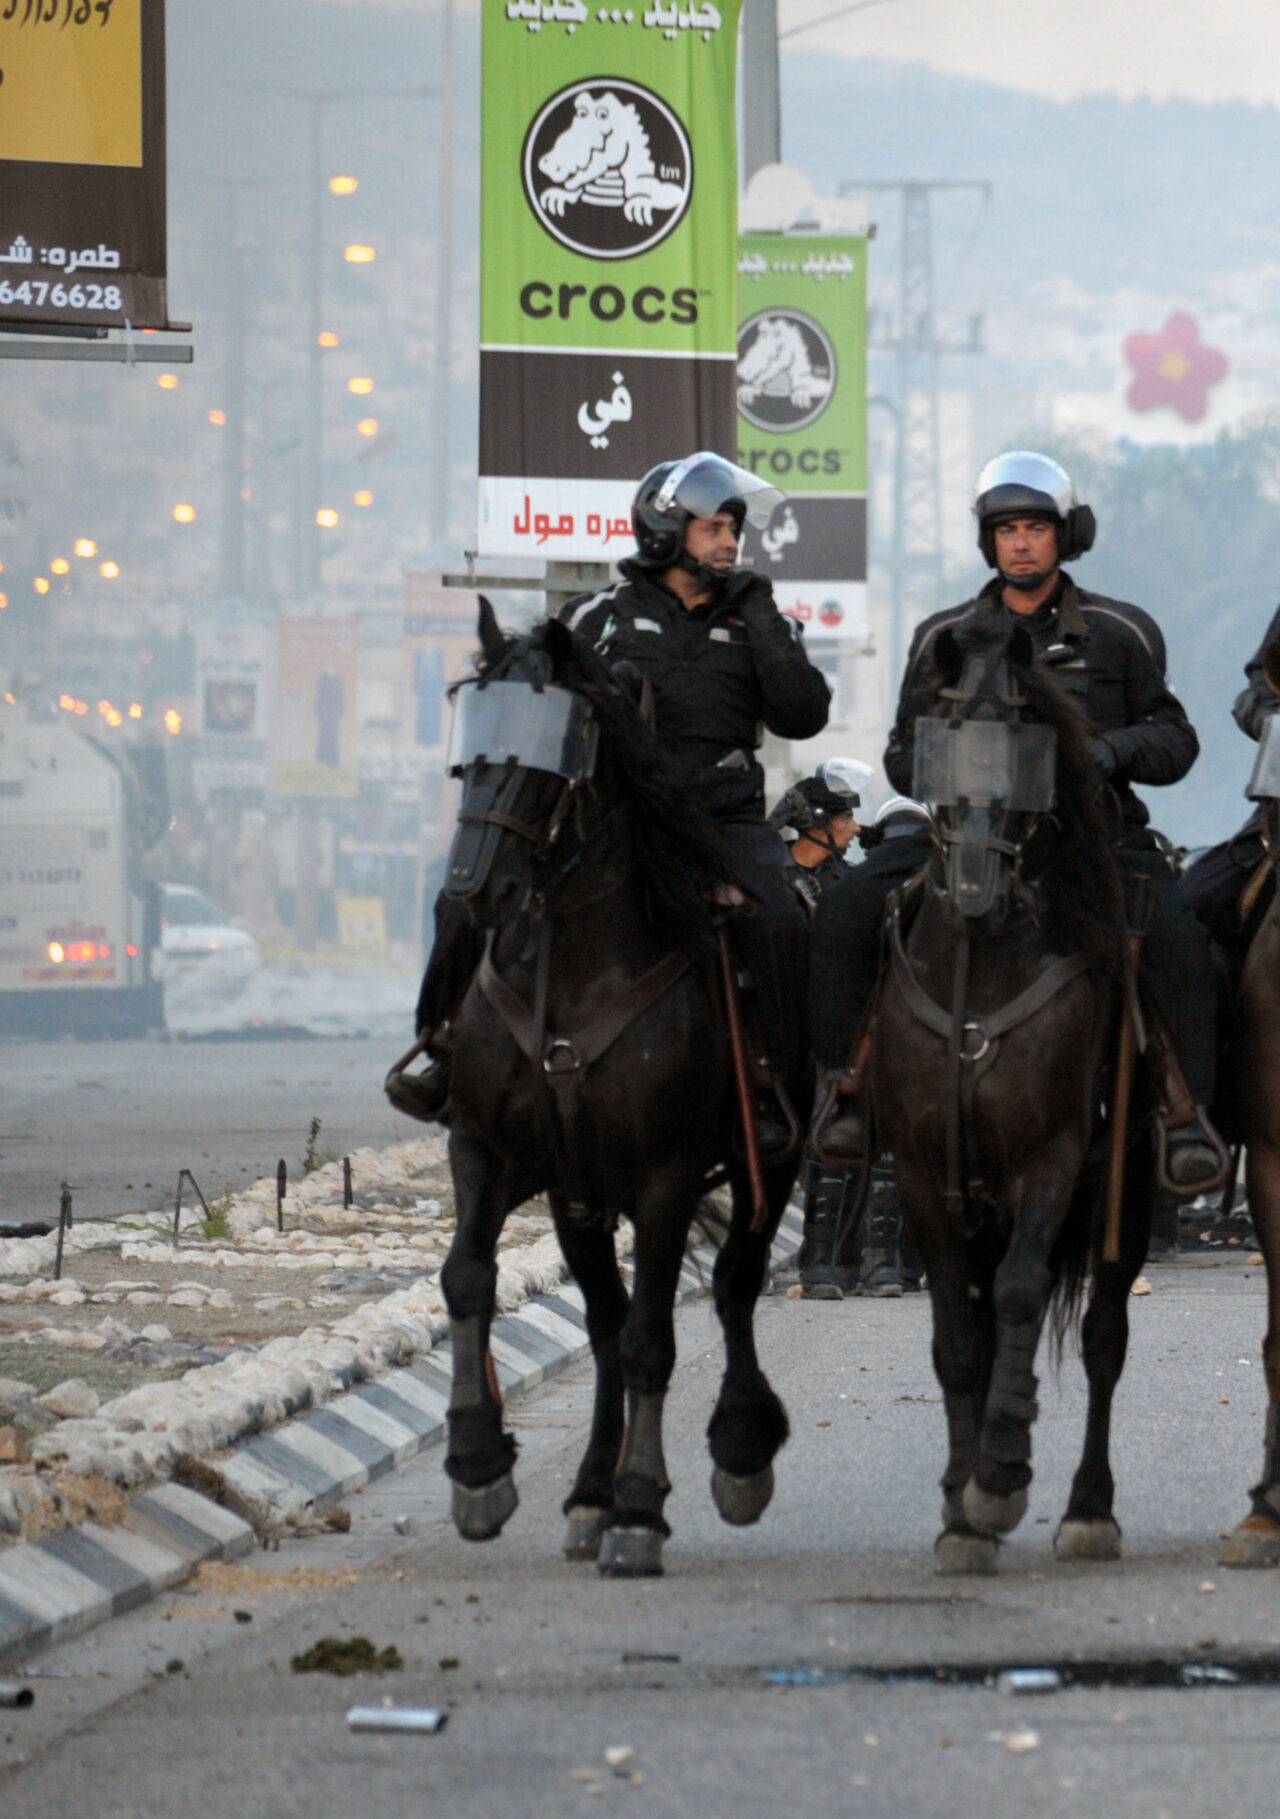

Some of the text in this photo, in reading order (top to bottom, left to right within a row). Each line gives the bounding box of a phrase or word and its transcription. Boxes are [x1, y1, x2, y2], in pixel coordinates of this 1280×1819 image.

[519, 281, 699, 324] crocs
[577, 368, 633, 450] في
[513, 494, 575, 546] مول
[586, 512, 635, 546] مره
